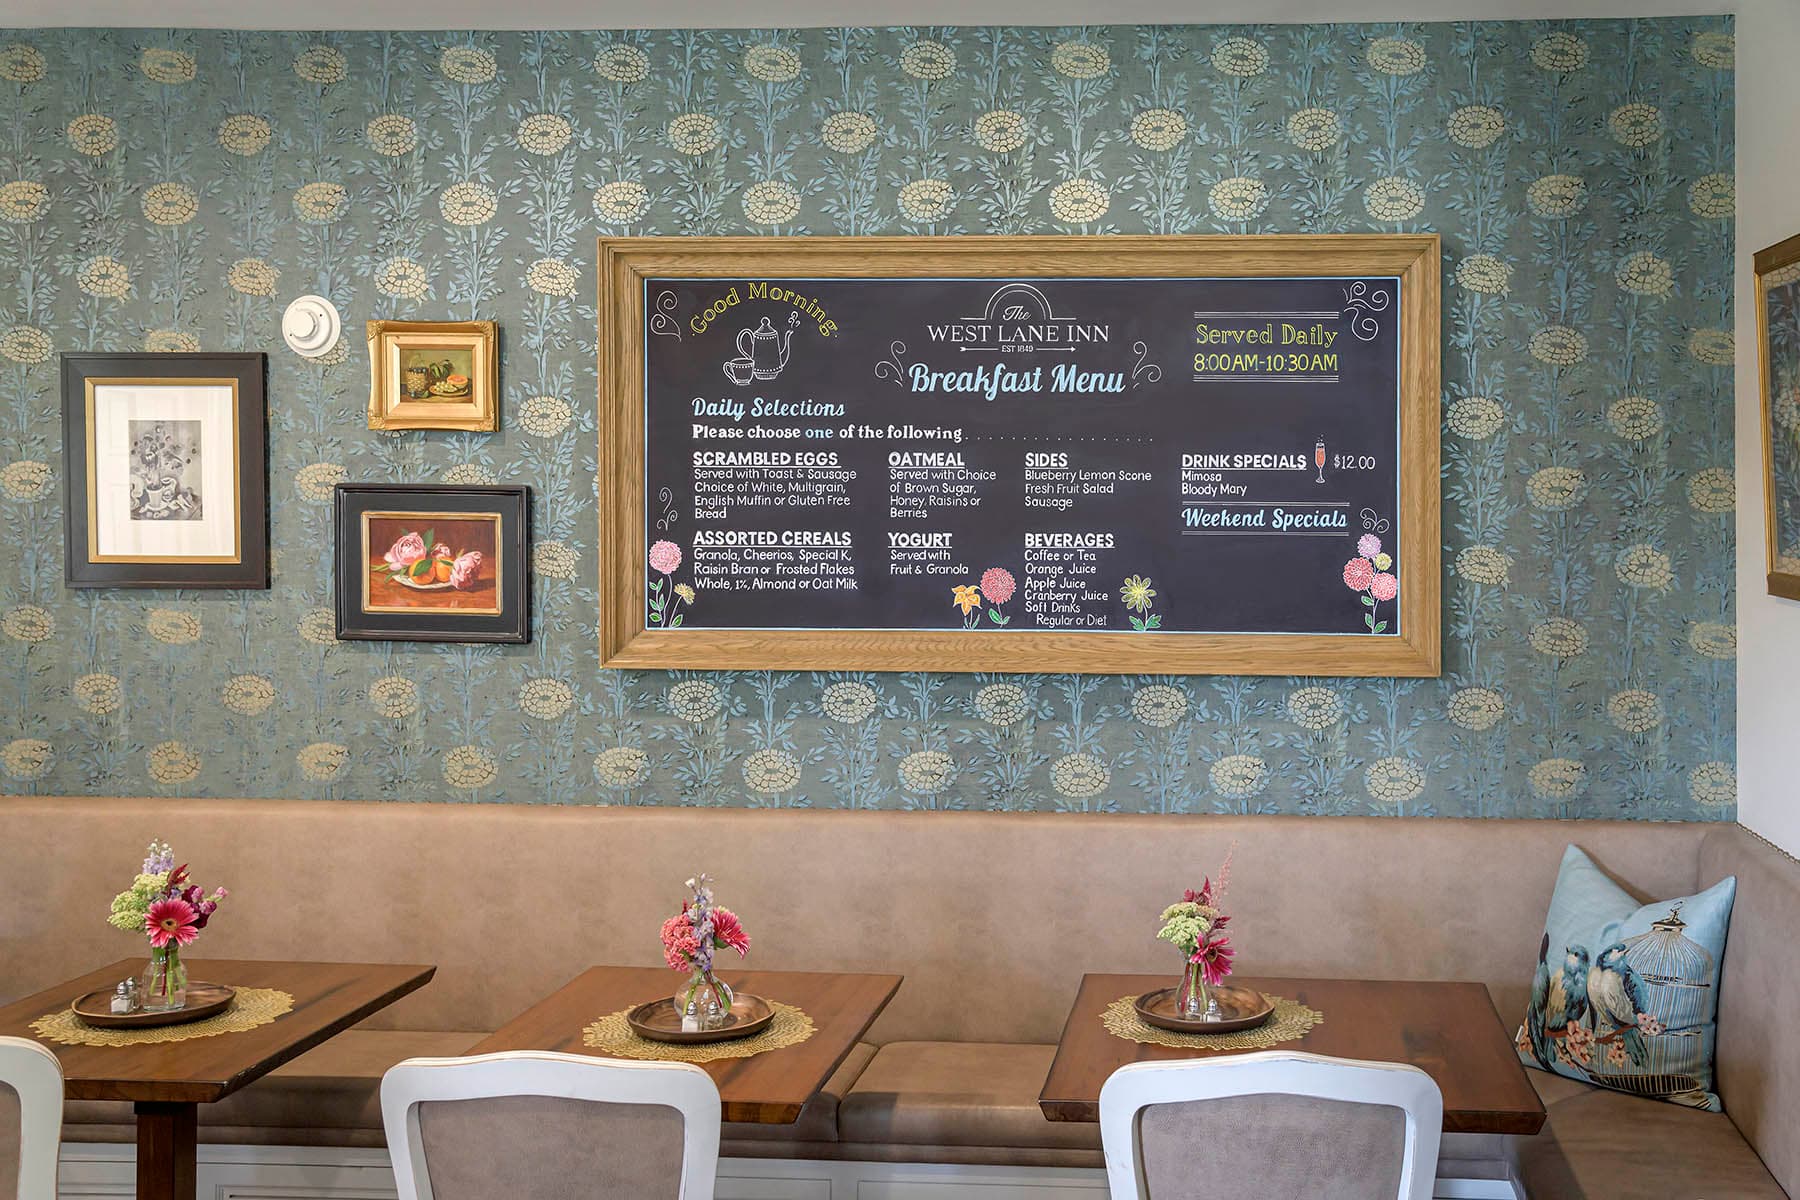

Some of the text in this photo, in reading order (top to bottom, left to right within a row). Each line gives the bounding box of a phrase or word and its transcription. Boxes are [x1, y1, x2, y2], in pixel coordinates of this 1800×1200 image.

[690, 282, 838, 337] Good Morning
[1003, 306, 1031, 320] The
[927, 325, 1108, 342] WEST LANE INN
[1197, 324, 1338, 348] Served Daily
[909, 363, 1126, 401] Breakfast Menu
[692, 398, 845, 421] Daily Selections
[693, 424, 744, 438] Please
[747, 425, 801, 438] choose
[805, 429, 833, 438] one
[839, 424, 855, 438] of
[858, 425, 884, 438] the
[693, 452, 837, 466] SCRAMBLED EGGS
[888, 452, 965, 467] OATMEAL
[1025, 452, 1068, 467] SIDES
[1182, 454, 1375, 469] DRINK SPECIALS $12.00
[695, 468, 856, 482] Served with Toast & Sausage
[890, 469, 996, 480] Served with Choice
[1025, 470, 1151, 484] Blueberry Lemon Scone
[1182, 470, 1221, 481] Mimosa
[695, 482, 845, 495] Choice of White, Multigrain,
[890, 482, 976, 496] of Brown Sugar,
[1026, 483, 1113, 495] Fresh Fruit Salad
[1182, 483, 1247, 497] Bloody Mary
[695, 495, 850, 509] English Muffin or Gluten Free
[929, 495, 968, 506] Raisins
[1025, 496, 1072, 511] Sausage
[695, 508, 726, 518] Bread
[891, 508, 927, 518] Berries
[1181, 508, 1347, 531] Weekend Specials
[693, 531, 851, 545] ASSORTED CEREALS
[888, 532, 952, 547] YOGURT
[1025, 533, 1114, 547] BEVERAGES
[694, 548, 740, 561] Granola,
[744, 549, 794, 561] Cheerios,
[799, 549, 838, 562] Special
[891, 550, 950, 560] Served with
[1025, 550, 1096, 561] Coffee or Tea
[694, 563, 728, 574] Raisin
[731, 563, 758, 574] Bran
[776, 563, 817, 574] Frosted
[820, 563, 854, 575] Flakes
[891, 563, 968, 575] Fruit & Granola
[1025, 563, 1096, 577] Orange Juice
[695, 577, 732, 590] Whole,
[752, 578, 796, 589] Almond
[799, 581, 810, 589] or
[812, 578, 833, 590] Oat
[836, 578, 858, 589] Milk
[1025, 577, 1086, 591] Apple Juice
[1025, 590, 1108, 603] Cranberry Juice
[1025, 602, 1046, 612] Soft
[1037, 614, 1107, 628] Regular or Diet
